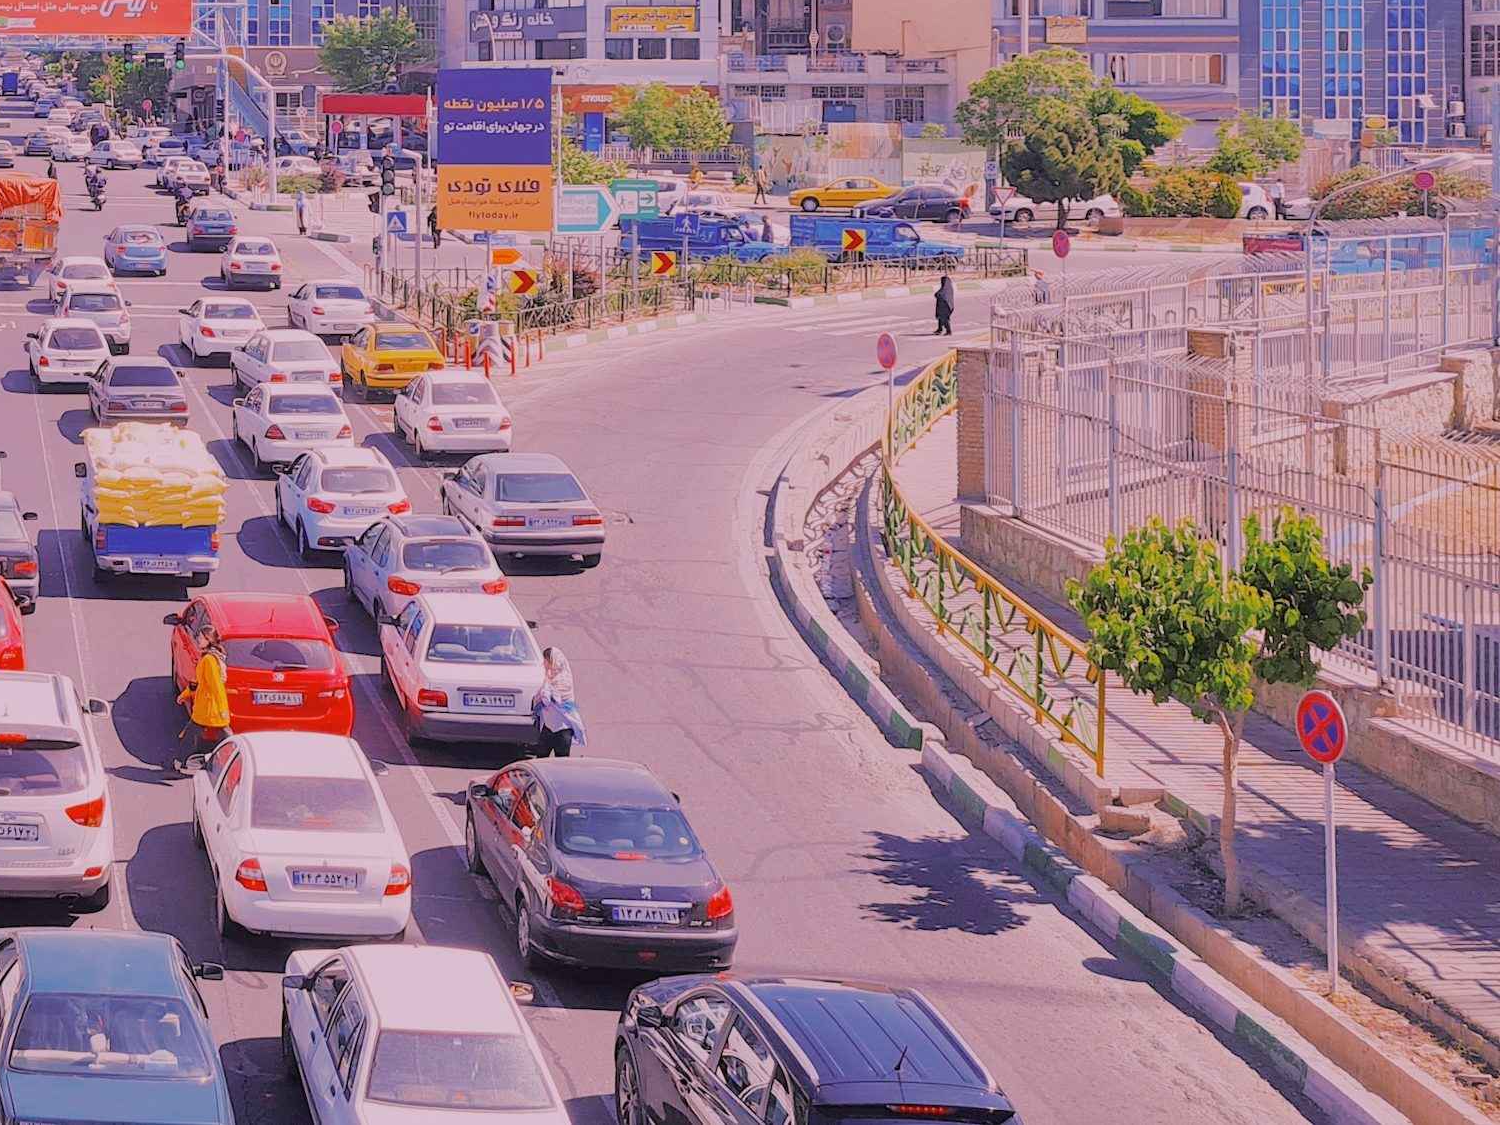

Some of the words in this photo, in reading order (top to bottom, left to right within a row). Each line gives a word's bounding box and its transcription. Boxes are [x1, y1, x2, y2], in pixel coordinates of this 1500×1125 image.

[58, 2, 79, 13] سالی
[80, 2, 98, 15] هیچ
[527, 12, 555, 26] خانه
[443, 98, 474, 109] نقطه
[476, 98, 519, 112] میلیون
[443, 121, 455, 134] تو
[455, 121, 485, 131] اقامت
[485, 121, 506, 133] برای
[506, 121, 532, 133] جهان
[533, 122, 545, 133] در
[448, 178, 491, 195] تودی
[498, 178, 540, 193] فلای
[469, 211, 518, 220] flytoday.ir
